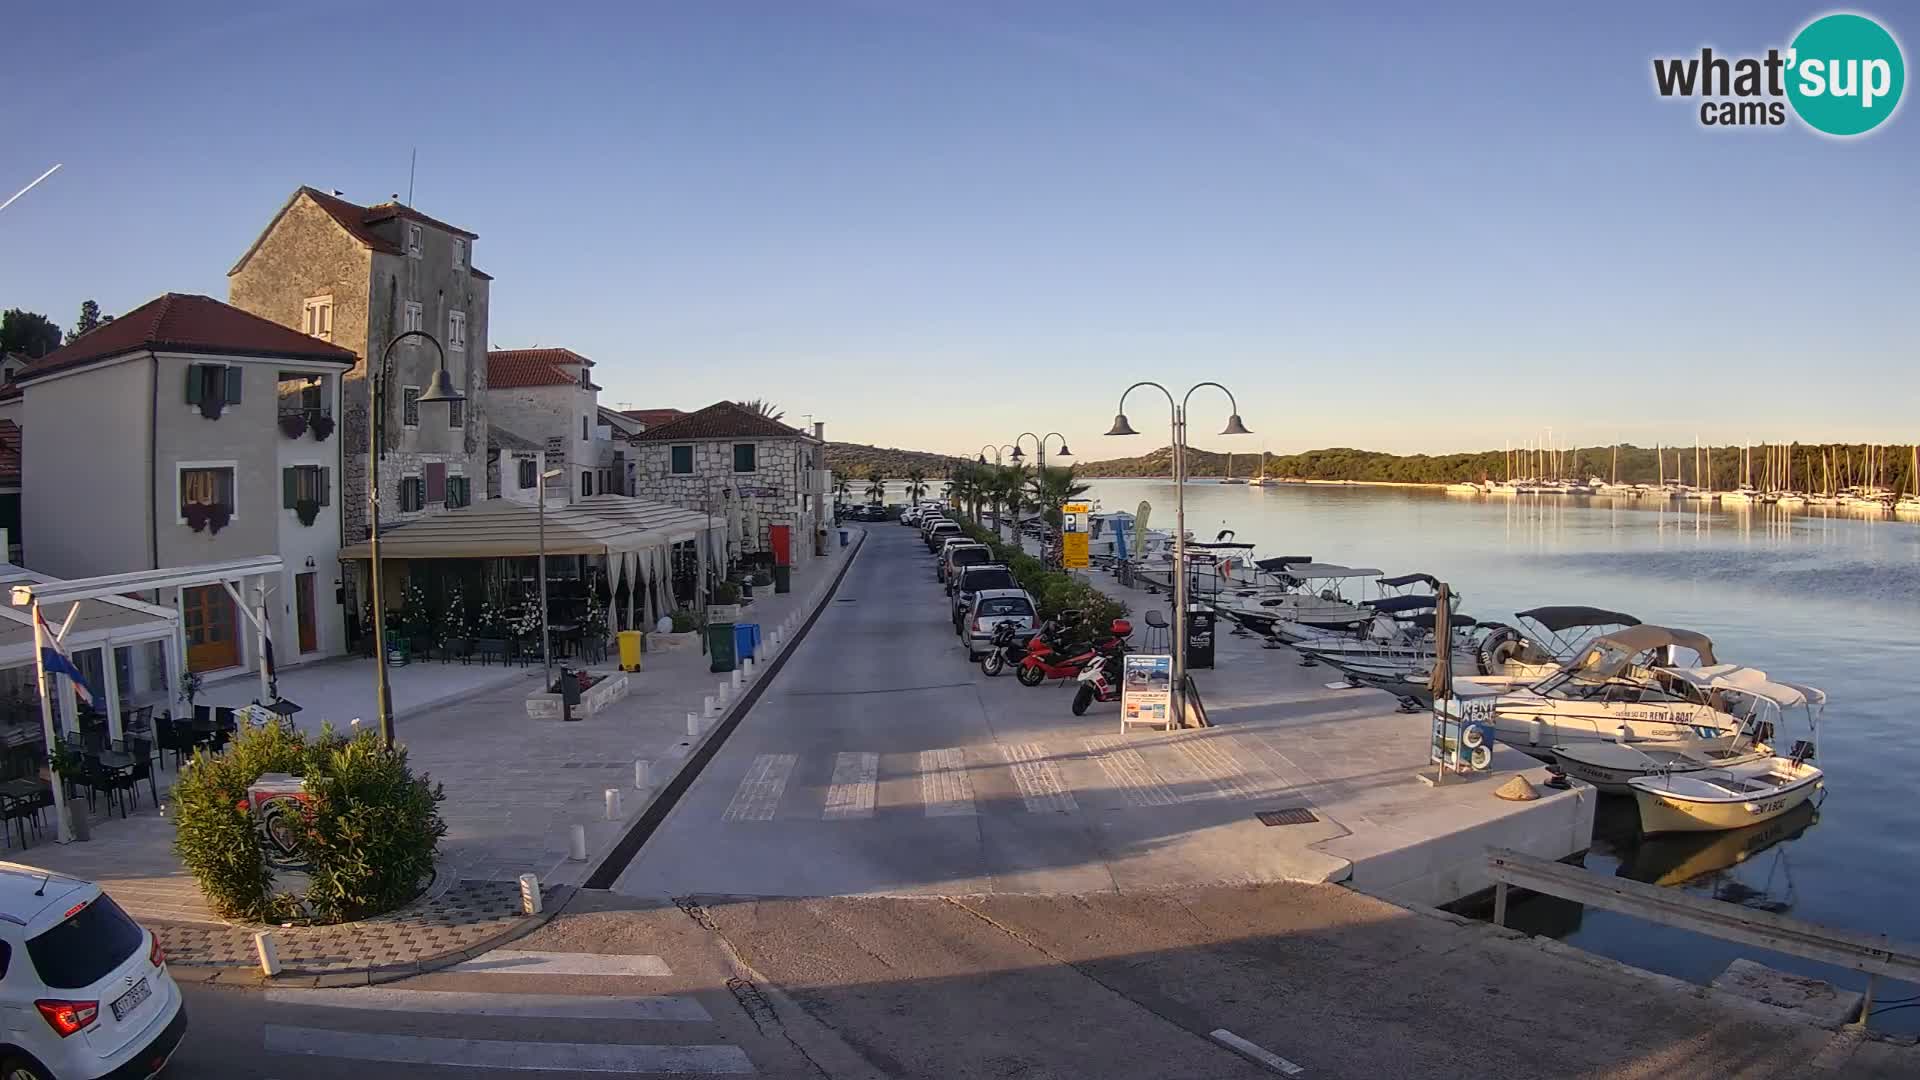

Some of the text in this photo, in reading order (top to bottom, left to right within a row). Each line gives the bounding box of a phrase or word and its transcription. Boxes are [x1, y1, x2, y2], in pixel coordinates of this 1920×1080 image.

[1065, 514, 1076, 531] P
[1463, 699, 1495, 713] RENT
[1462, 710, 1494, 722] A BOAT
[1649, 711, 1668, 722] RENT
[1676, 711, 1695, 724] BOAT
